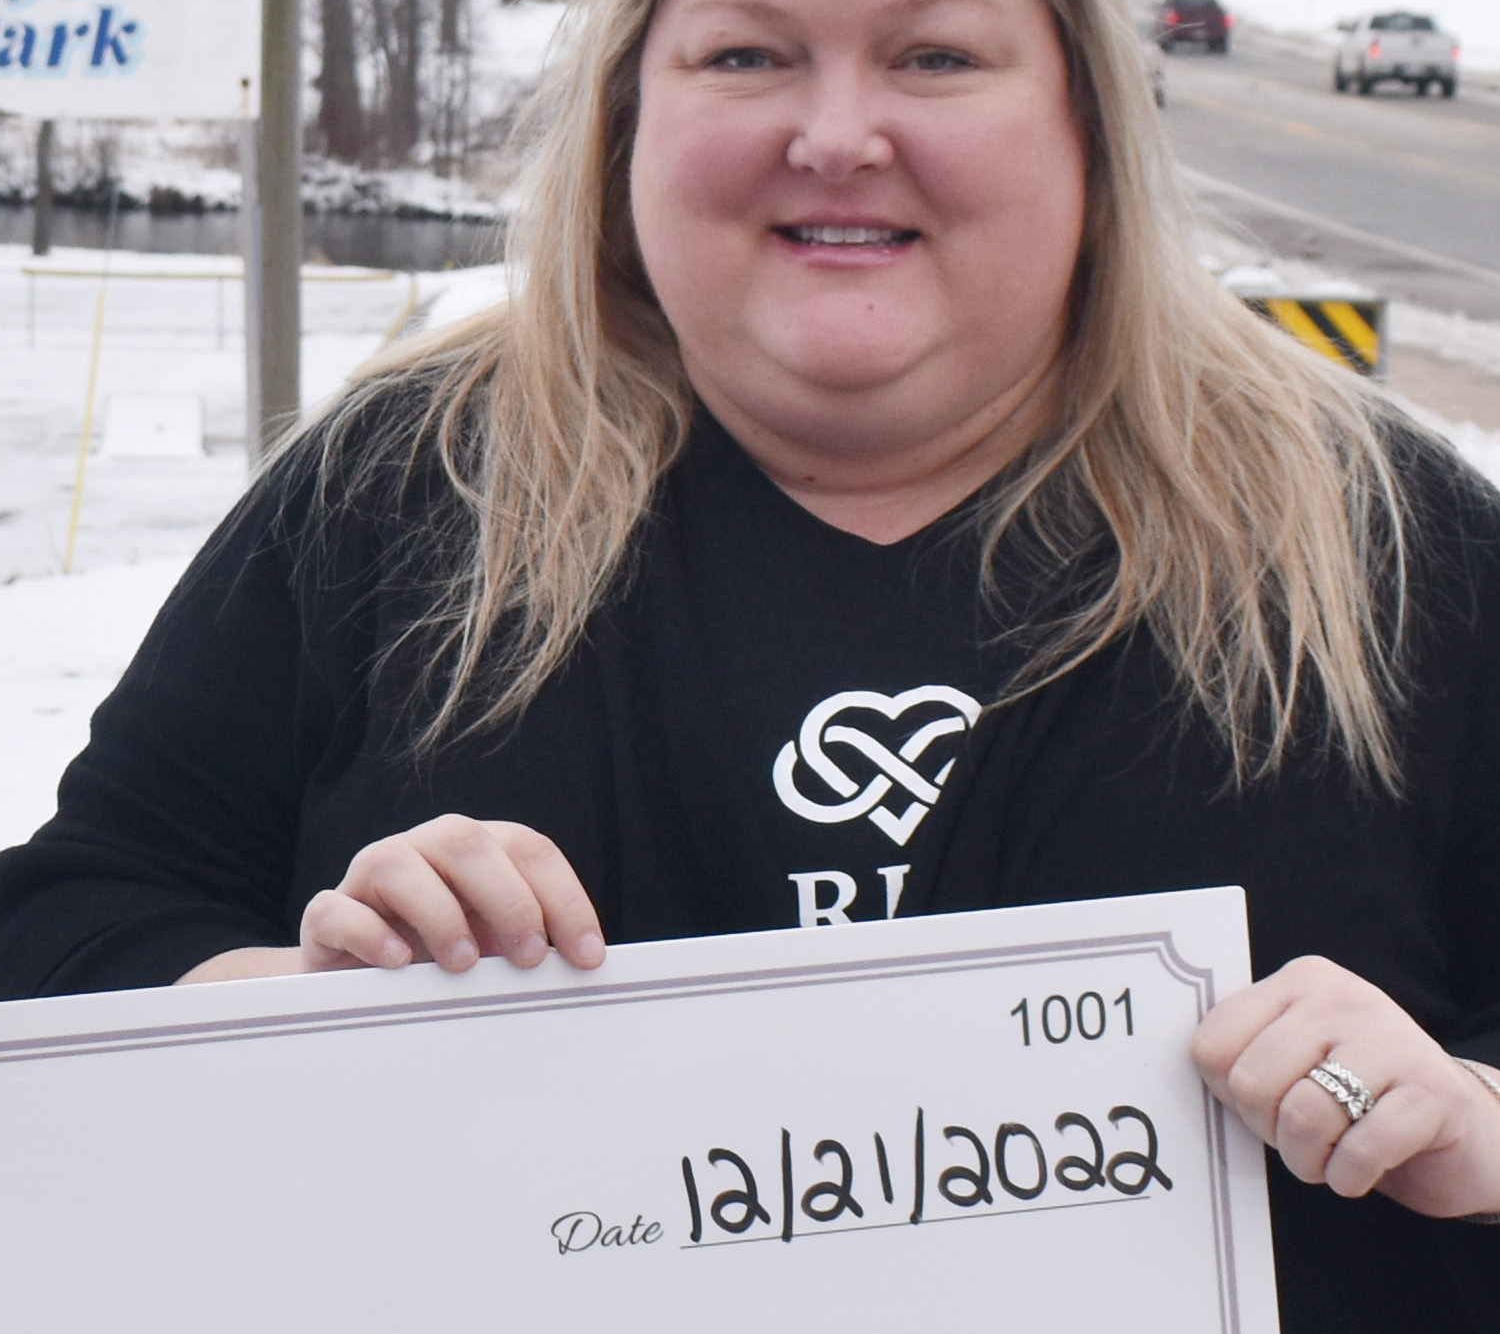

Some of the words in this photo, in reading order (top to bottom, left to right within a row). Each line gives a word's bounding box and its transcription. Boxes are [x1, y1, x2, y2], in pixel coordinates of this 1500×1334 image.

[1010, 988, 1134, 1046] 1001
[682, 1105, 1173, 1242] 12/21/2022
[551, 1210, 663, 1254] Date
